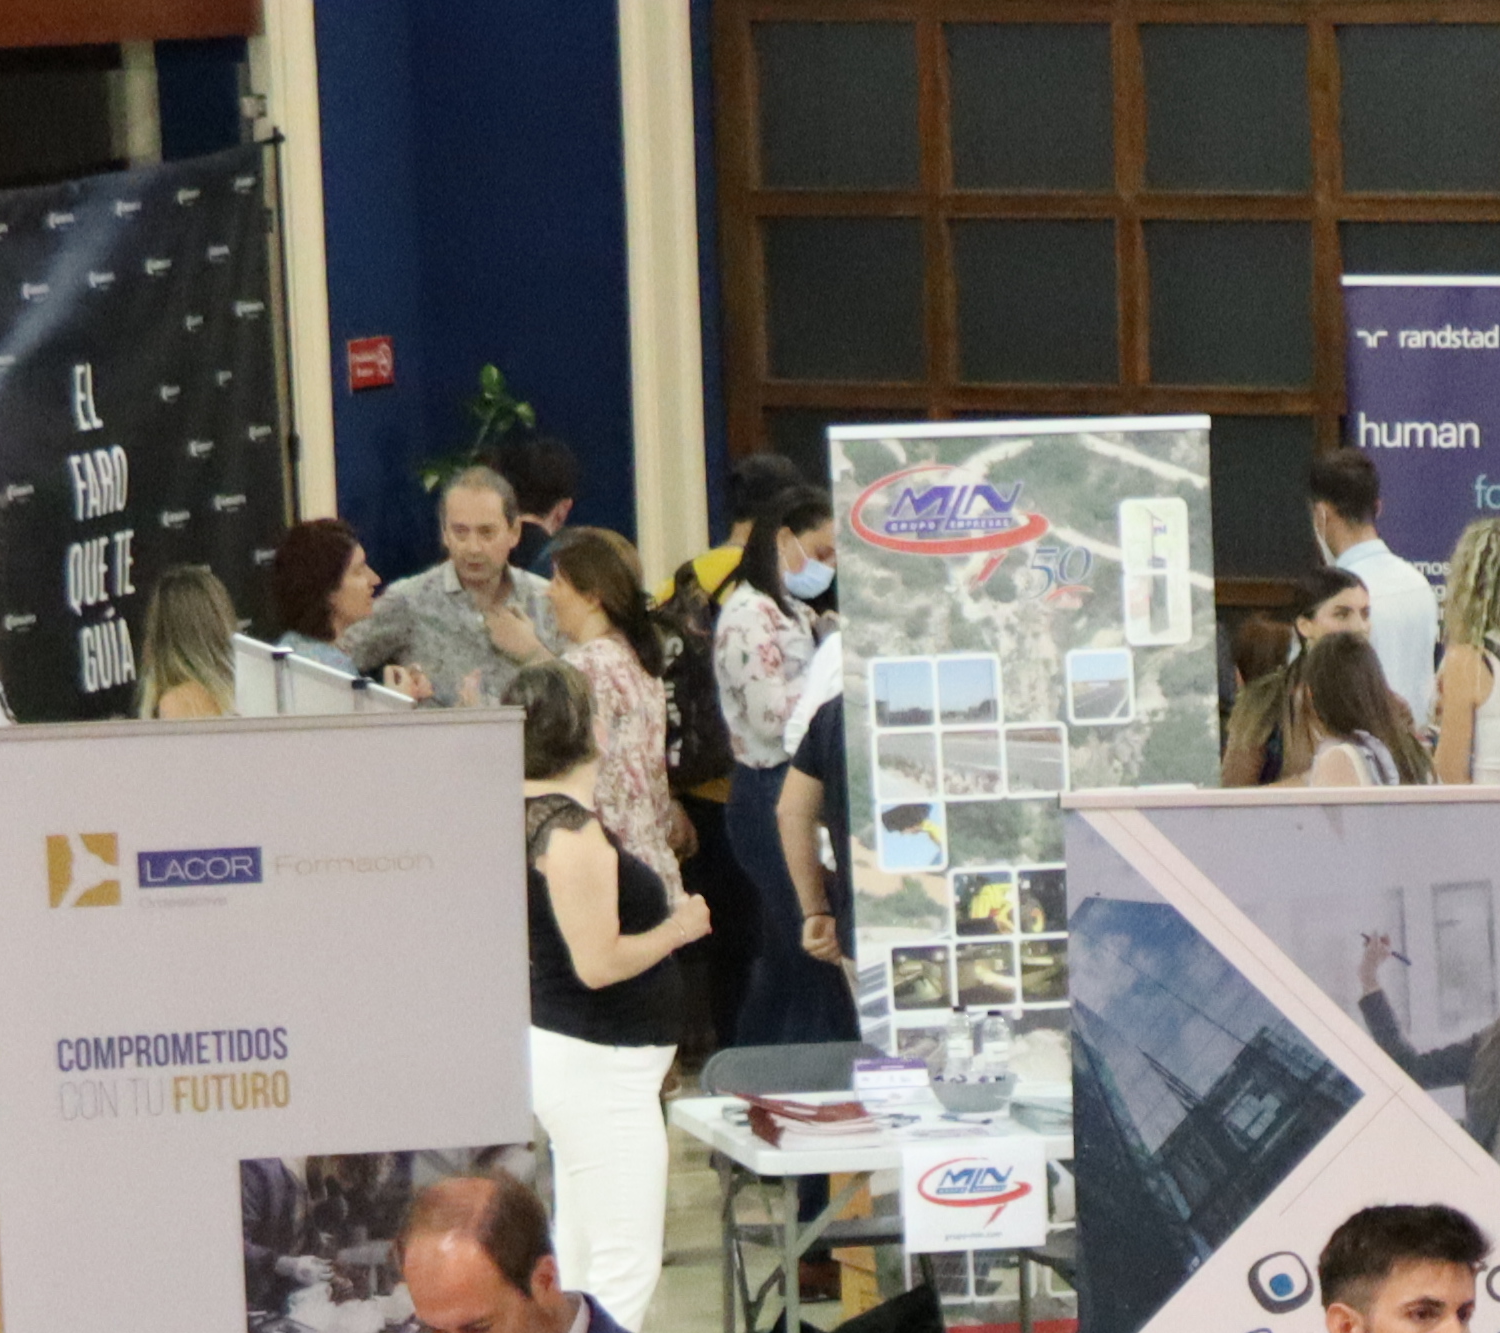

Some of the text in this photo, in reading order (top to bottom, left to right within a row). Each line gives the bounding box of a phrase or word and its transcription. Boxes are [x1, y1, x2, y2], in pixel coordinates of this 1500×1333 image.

[1399, 324, 1500, 348] randstad
[73, 363, 103, 432] EL
[1359, 412, 1481, 448] human
[67, 445, 128, 521] FARO
[67, 531, 135, 617] QUE TE
[145, 850, 435, 883] LACOR Formación
[58, 1027, 288, 1072] COMPROMETIDOS
[59, 1070, 290, 1120] CON TU FUTURO
